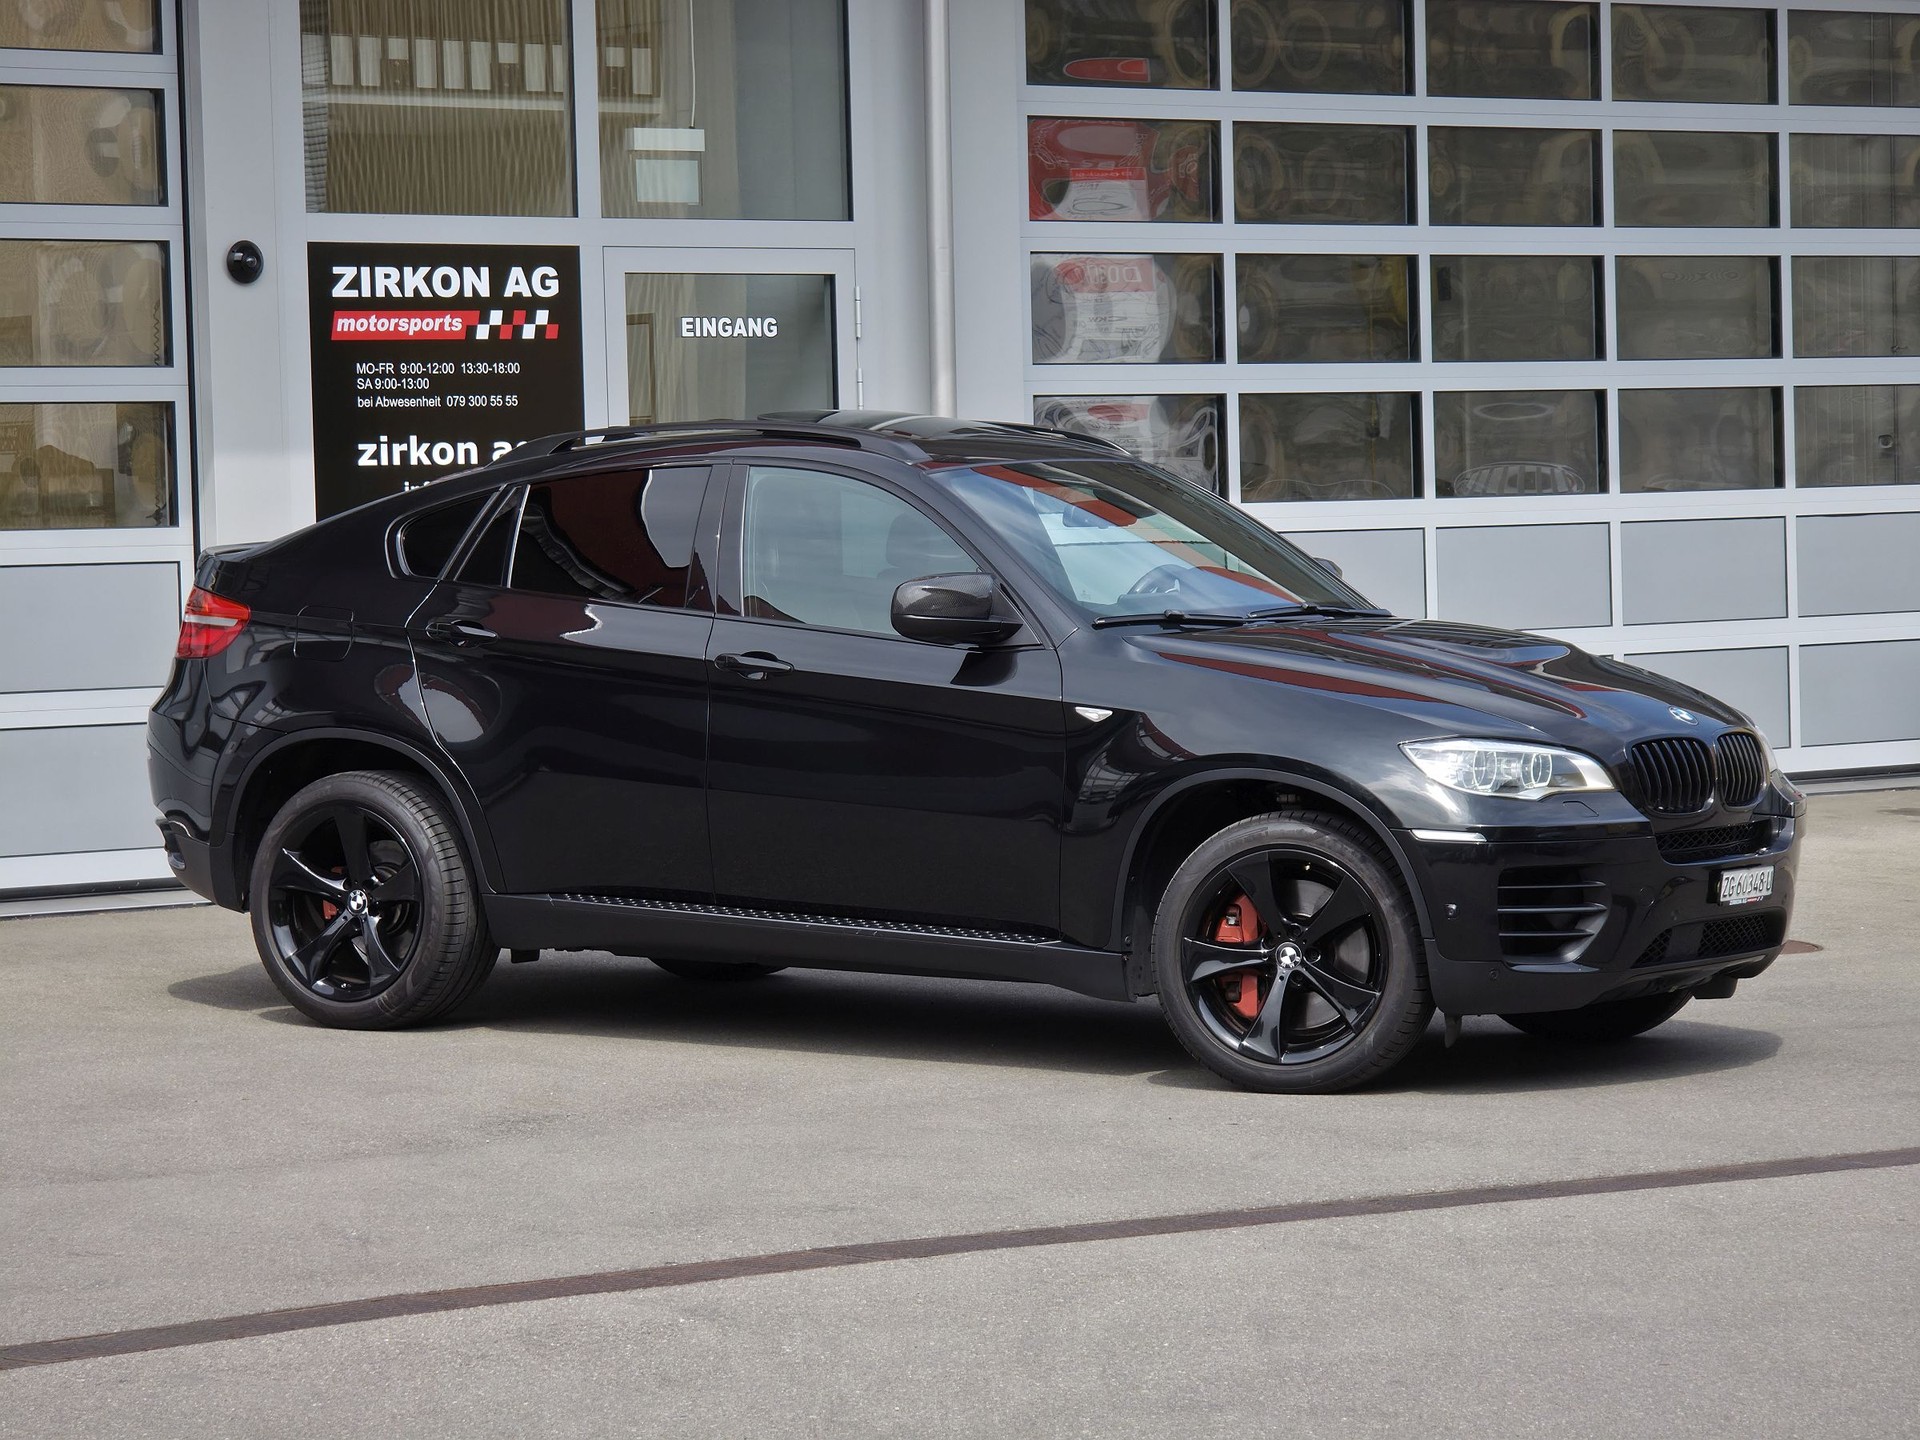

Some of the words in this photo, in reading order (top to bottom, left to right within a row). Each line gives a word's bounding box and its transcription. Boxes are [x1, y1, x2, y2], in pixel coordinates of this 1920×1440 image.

[331, 266, 491, 298] ZIRKON
[503, 266, 560, 298] AG
[336, 313, 464, 336] motorsports
[680, 316, 778, 339] EINGANG
[356, 362, 395, 375] MO-FR
[400, 362, 455, 375] 9:00-12:00
[461, 362, 521, 374] 13:30-18:00
[356, 377, 374, 390] SA
[374, 377, 430, 390] 9:00-13:00
[357, 395, 374, 408] bei
[375, 395, 442, 408] Abwesenheit
[446, 395, 466, 407] 079
[468, 395, 488, 407] 300
[489, 395, 503, 407] 55
[505, 395, 519, 407] 55
[357, 434, 479, 467] zirkon
[491, 440, 528, 462] a
